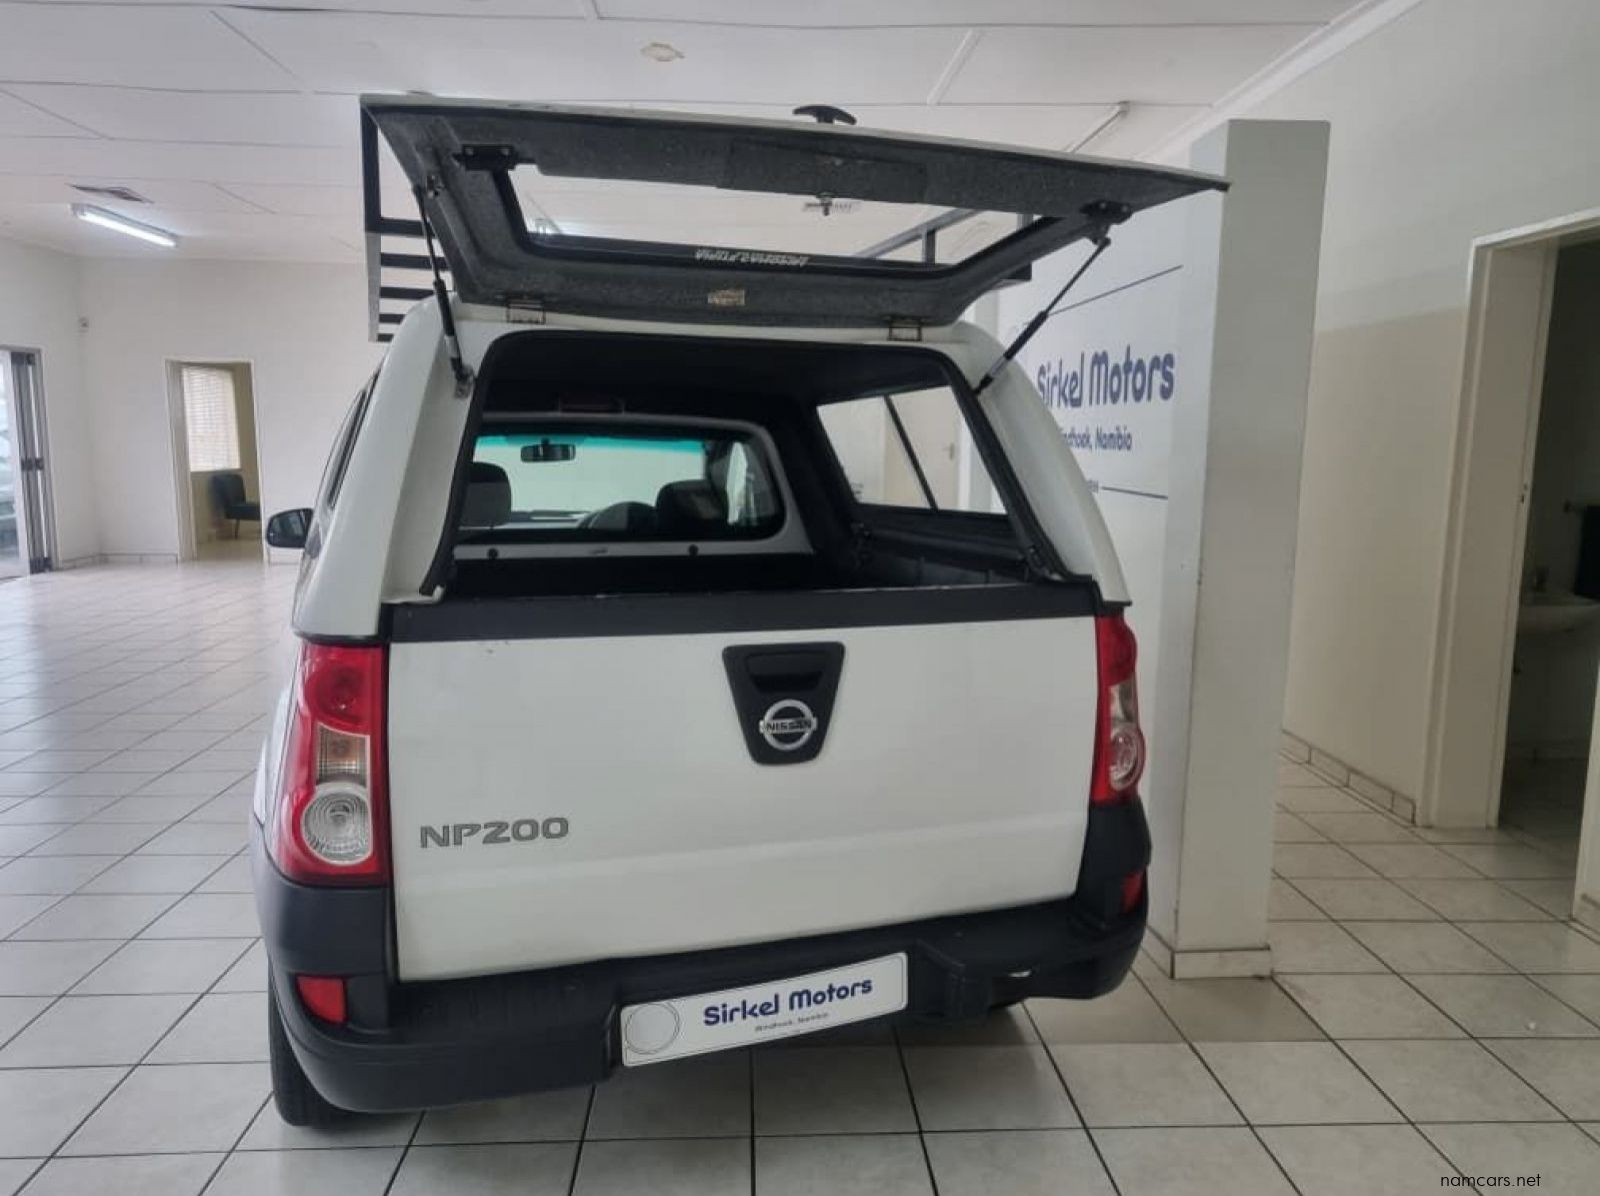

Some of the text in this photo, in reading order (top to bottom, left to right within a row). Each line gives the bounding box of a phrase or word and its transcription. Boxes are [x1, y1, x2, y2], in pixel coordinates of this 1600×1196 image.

[1037, 344, 1175, 408] Sirkel Motors
[420, 817, 569, 848] NP200
[704, 994, 779, 1026] Sirkel
[789, 979, 873, 1010] Motors
